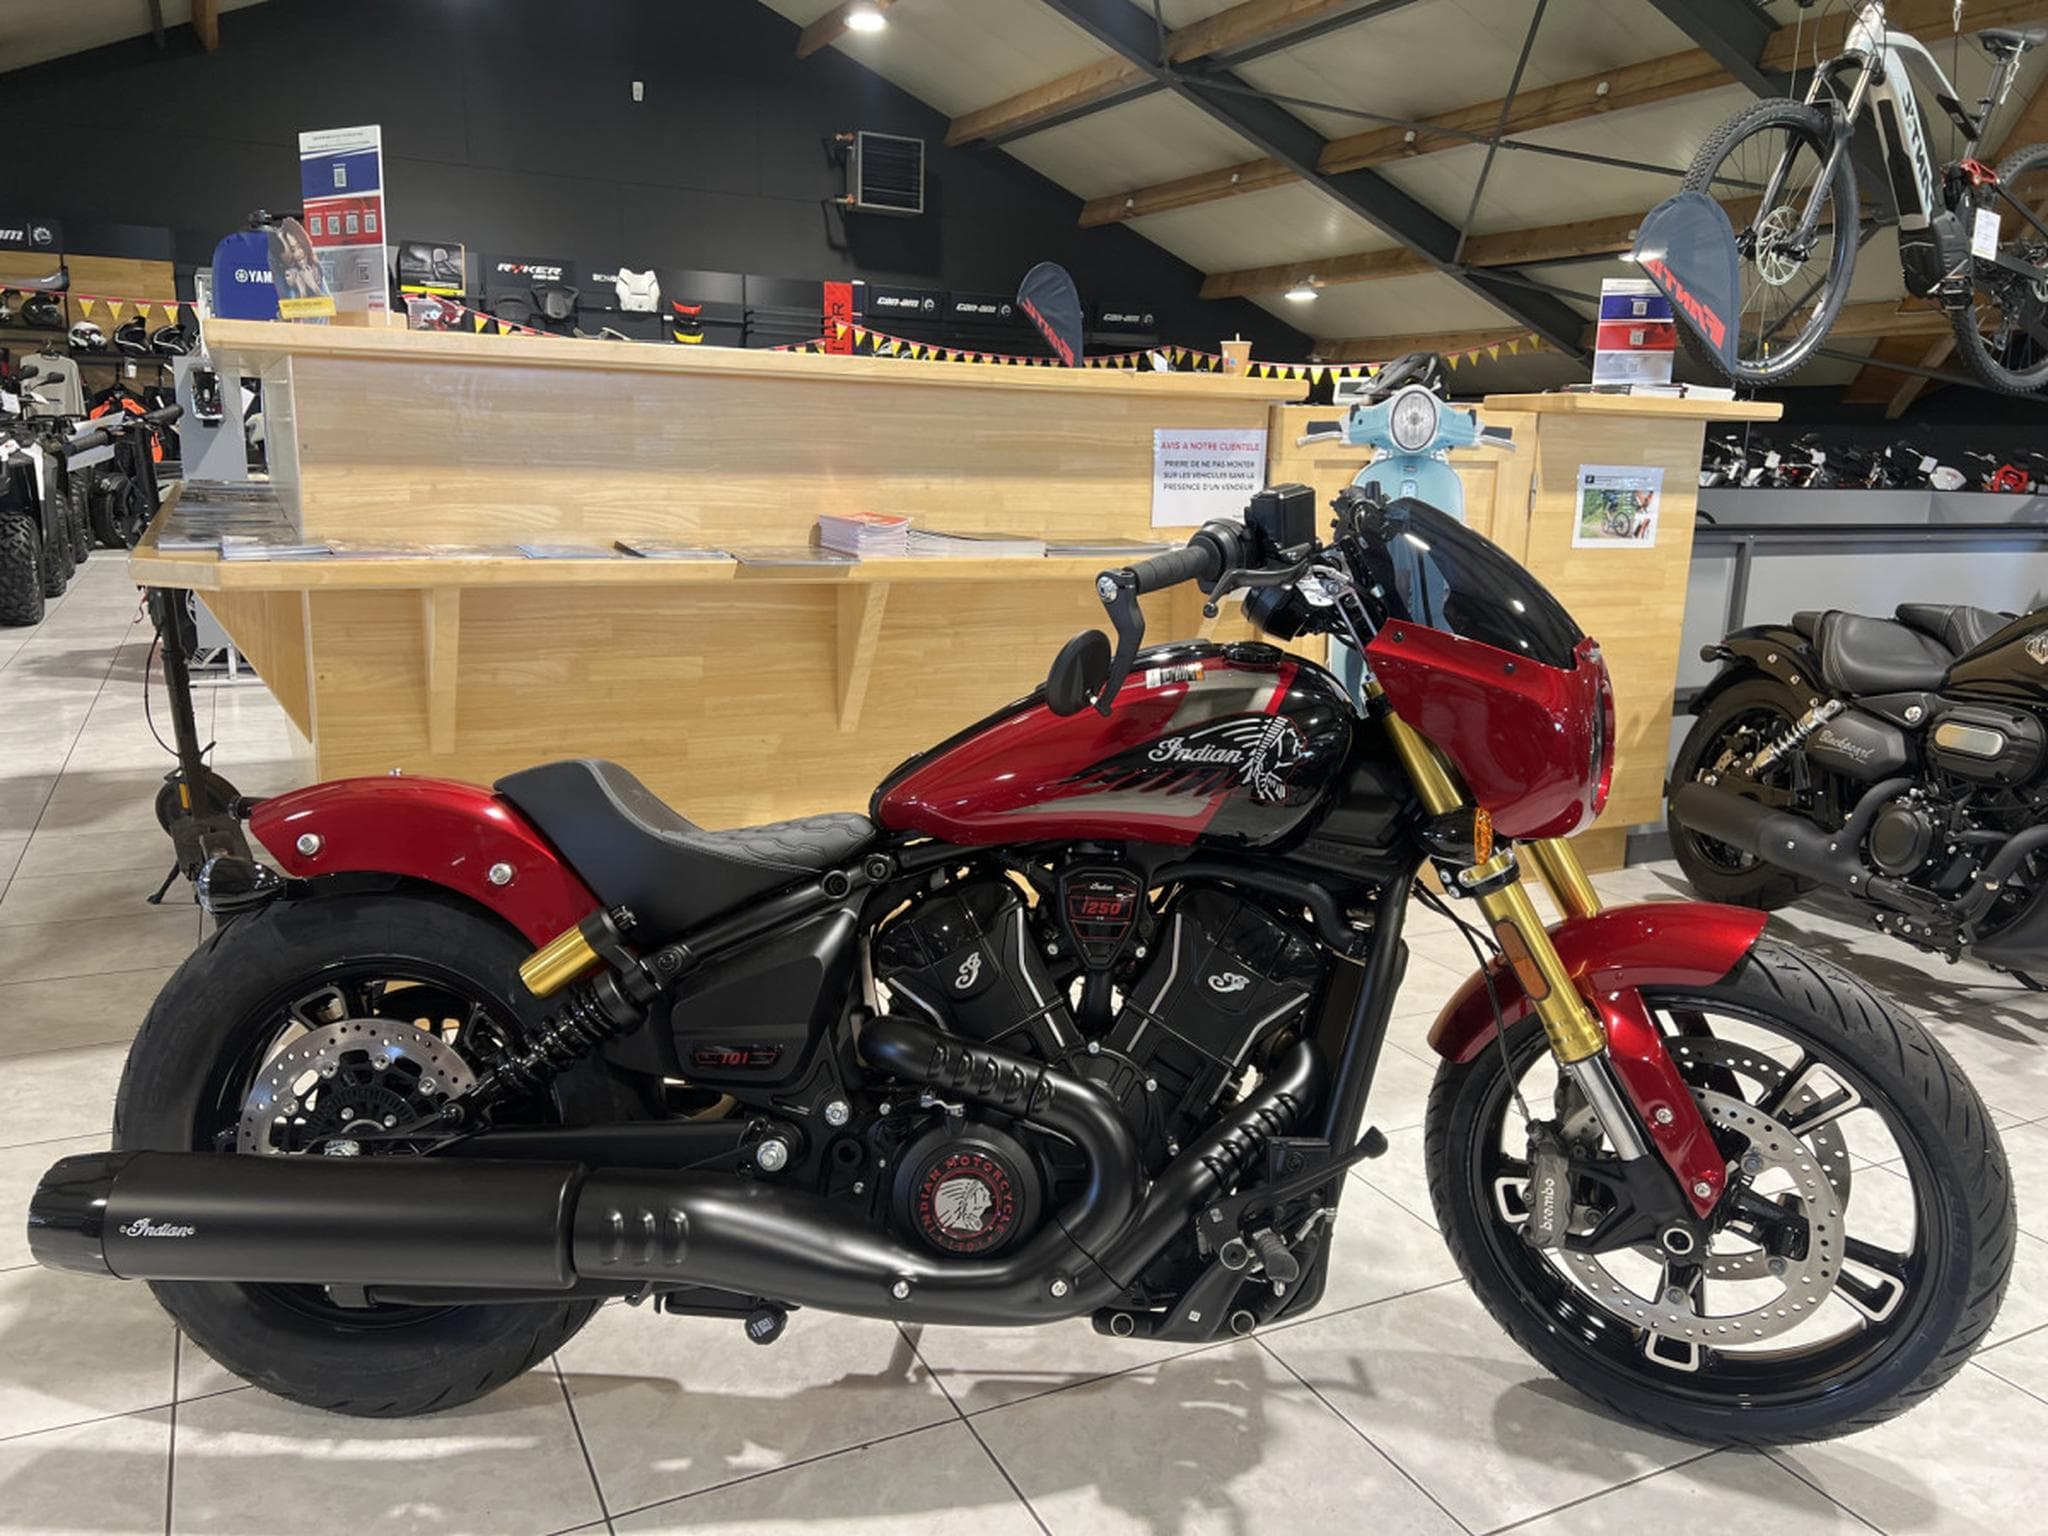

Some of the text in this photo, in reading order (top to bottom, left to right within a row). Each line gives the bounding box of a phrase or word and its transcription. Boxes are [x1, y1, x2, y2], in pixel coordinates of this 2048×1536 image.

[497, 262, 563, 276] RYKER
[1161, 441, 1180, 450] AVIS
[1190, 442, 1217, 451] NOTRE
[1219, 442, 1260, 452] CLIENTELE
[1164, 460, 1255, 469] PRIERE DE NE PAS MONTER
[1163, 471, 1255, 479] SUR LES VEHICULES SANS LA
[1163, 482, 1200, 491] PRESENCE
[1221, 482, 1254, 491] VENDEUR
[1147, 736, 1244, 763] Indian
[1081, 900, 1122, 915] 1250
[720, 1051, 748, 1066] 101
[944, 1154, 1014, 1234] MOTORCYCLE
[1539, 1178, 1555, 1231] brembo
[126, 1217, 188, 1237] Indian
